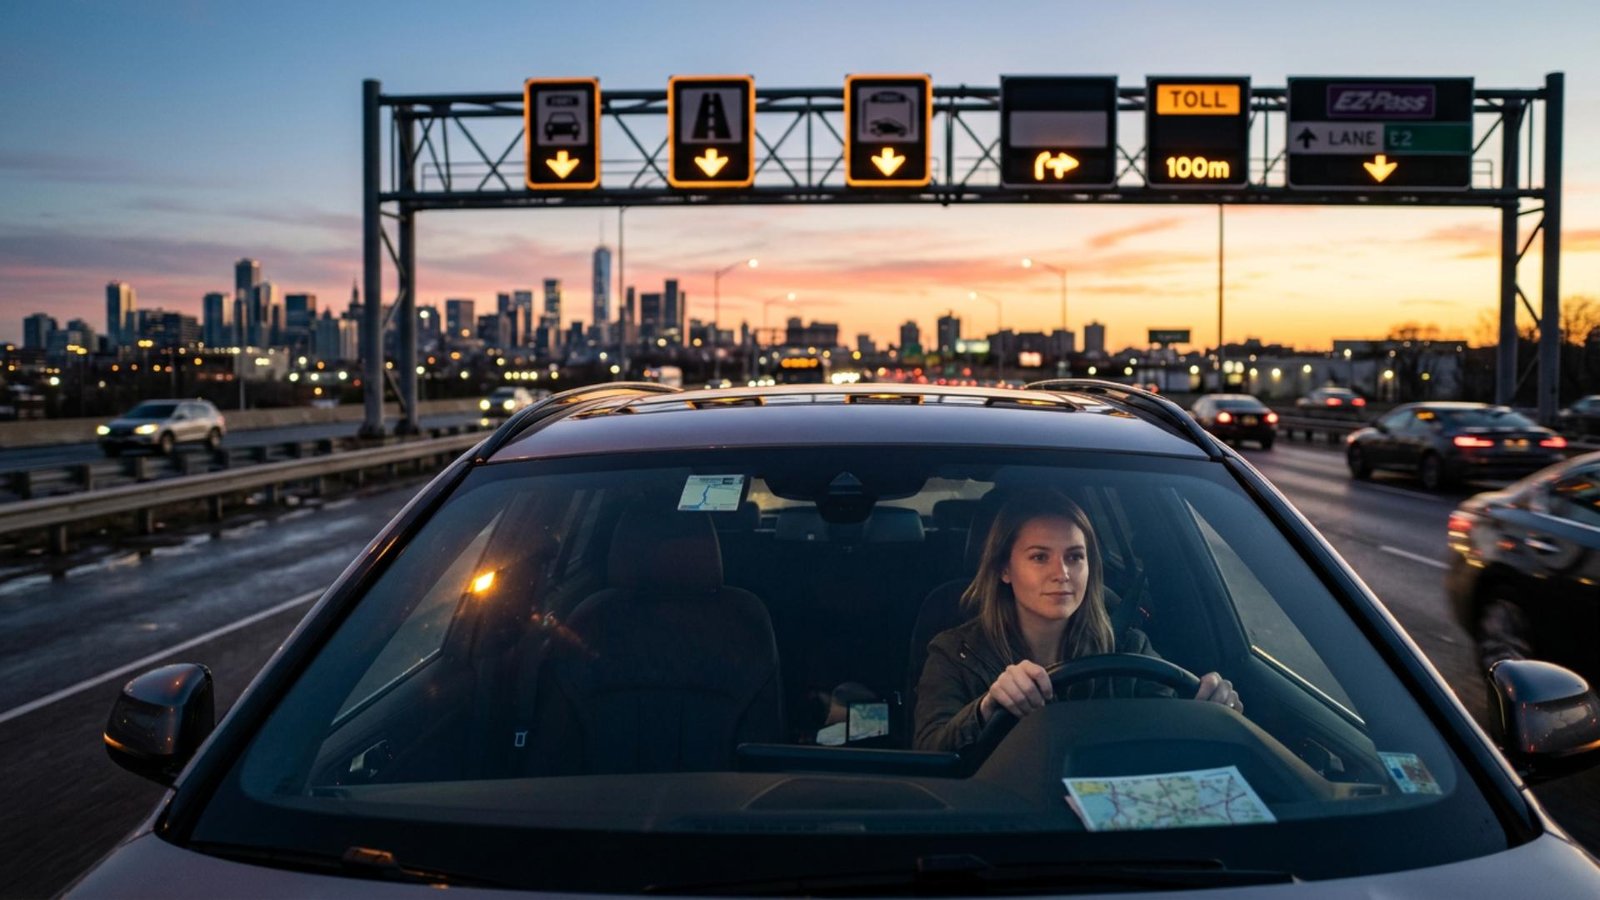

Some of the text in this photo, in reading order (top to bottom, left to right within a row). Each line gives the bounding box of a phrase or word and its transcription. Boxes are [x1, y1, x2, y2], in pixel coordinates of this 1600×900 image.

[1170, 90, 1227, 107] TOLL
[1333, 90, 1427, 111] EZ-Pass
[1328, 130, 1412, 147] LANE E2
[1166, 156, 1230, 178] 100m
